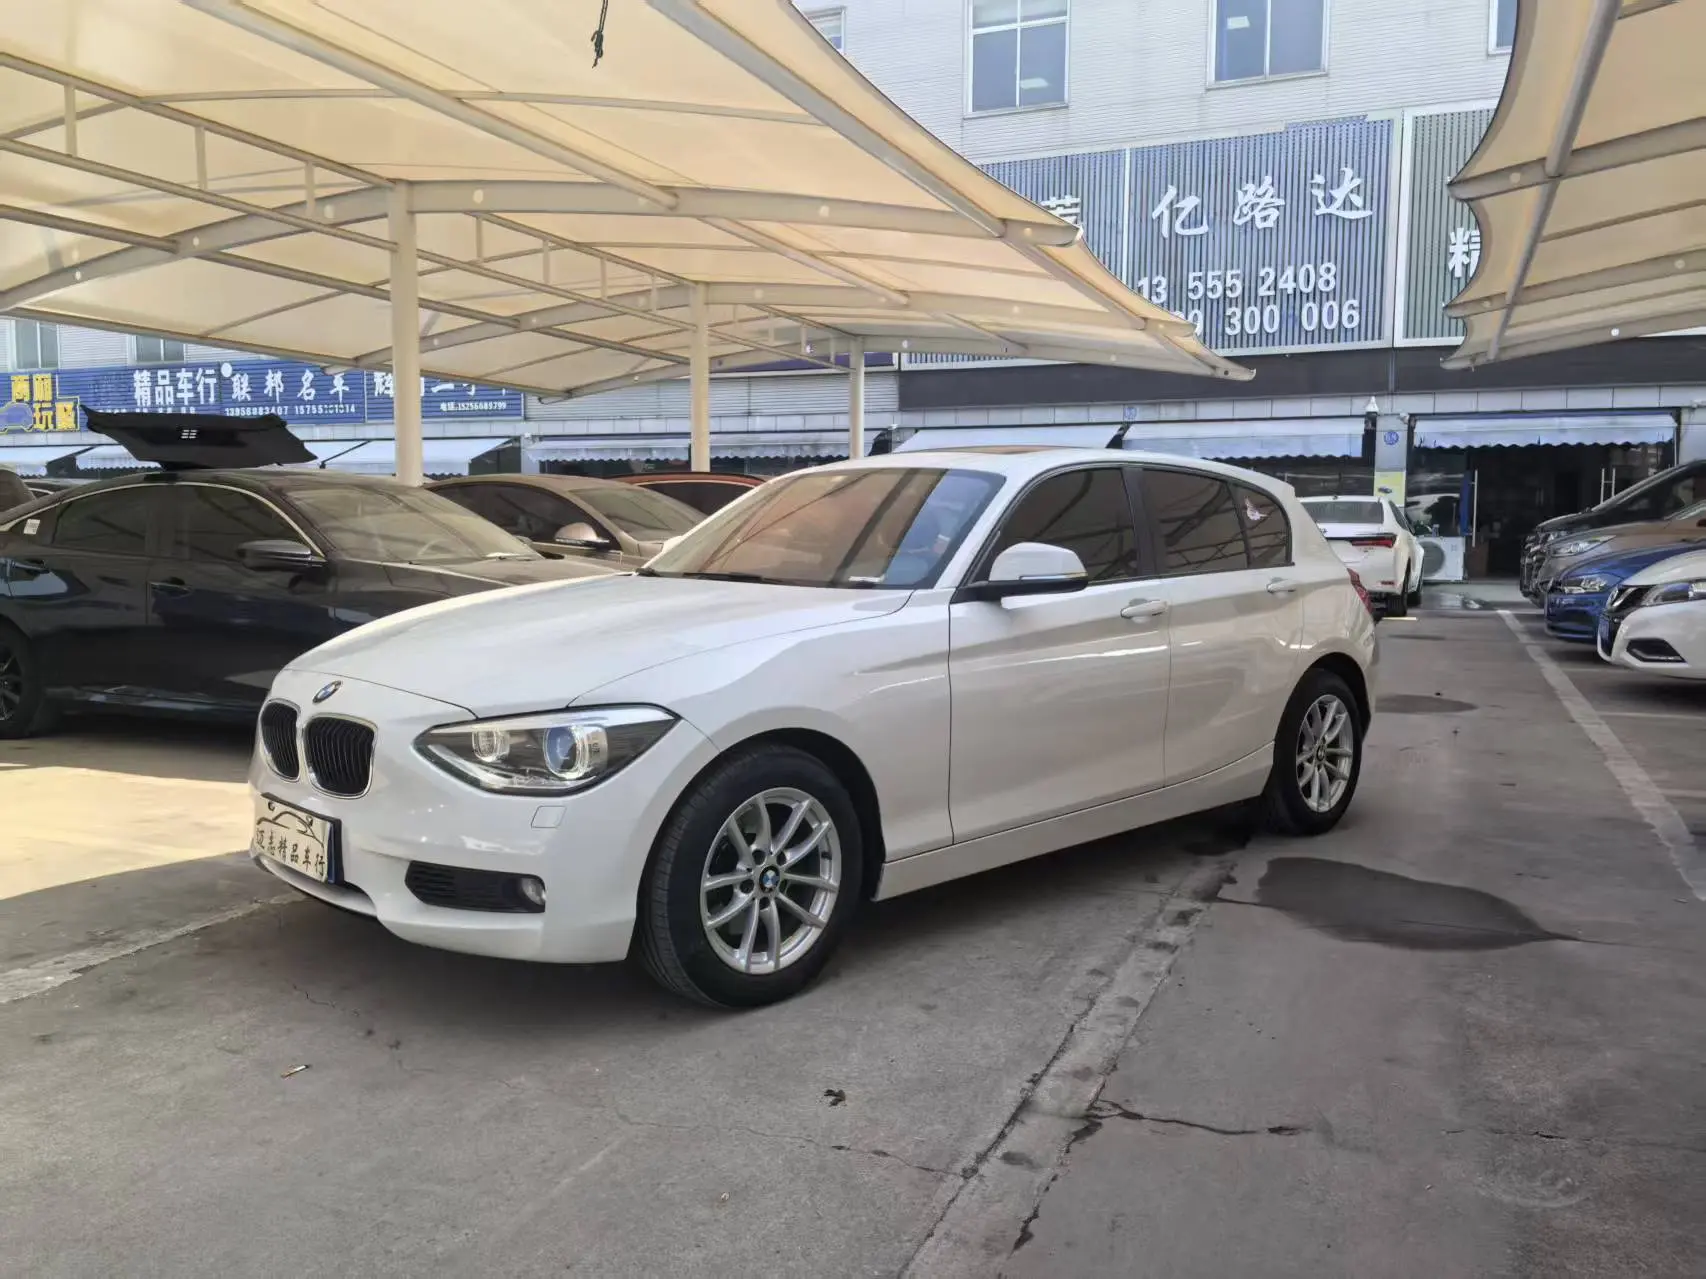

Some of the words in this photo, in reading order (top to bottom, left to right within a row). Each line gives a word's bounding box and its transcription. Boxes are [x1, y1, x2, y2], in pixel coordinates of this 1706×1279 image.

[1151, 167, 1373, 239] 亿路达
[1188, 270, 1242, 301] 555
[1258, 262, 1336, 297] 2408
[1224, 305, 1280, 335] 300
[1301, 299, 1360, 331] 006
[133, 367, 217, 407] 精品车行
